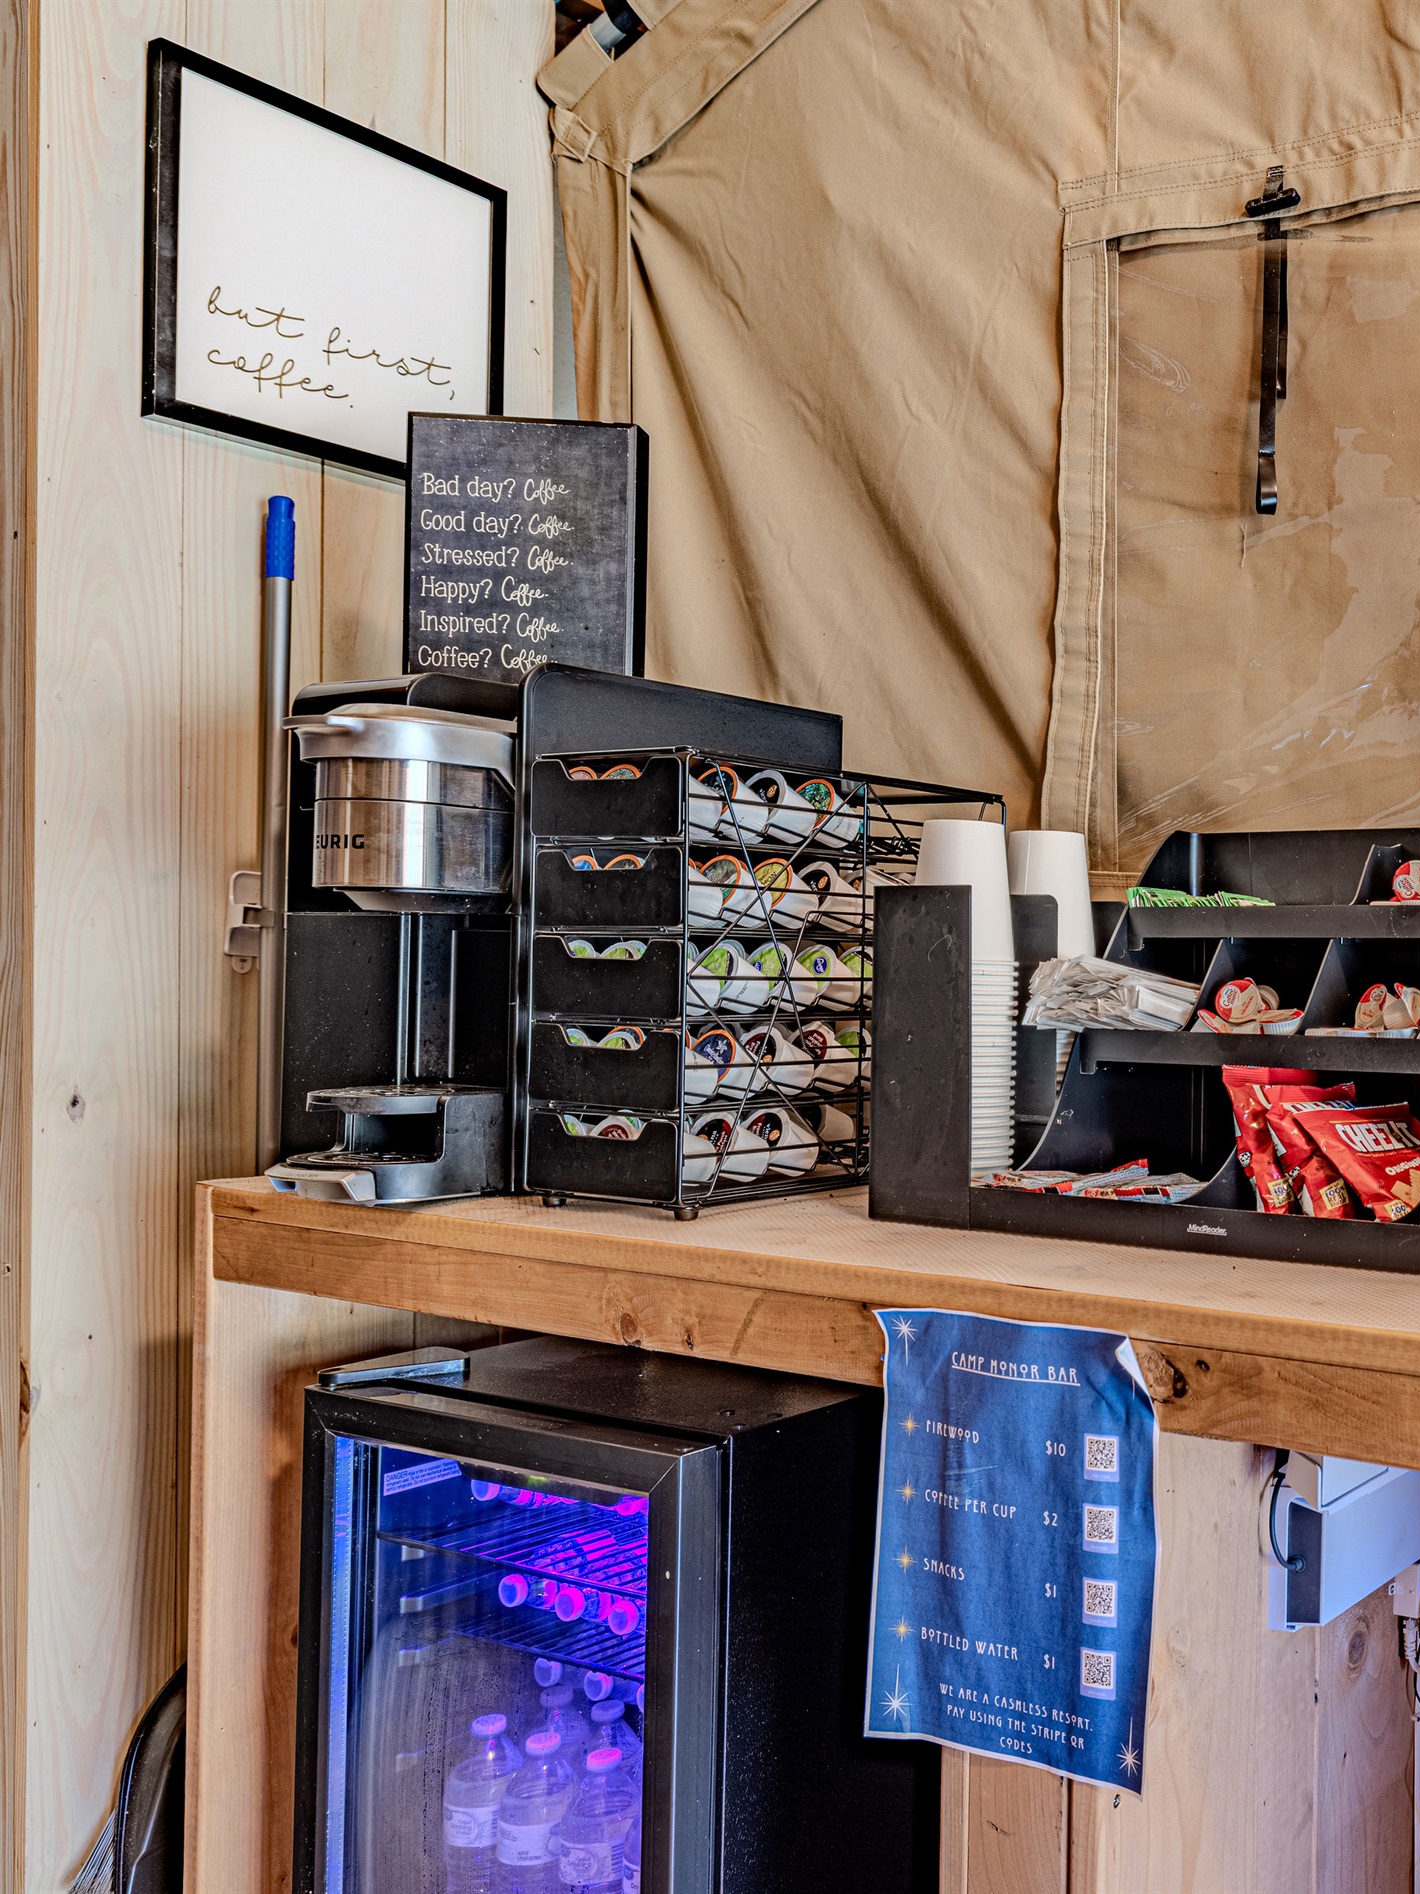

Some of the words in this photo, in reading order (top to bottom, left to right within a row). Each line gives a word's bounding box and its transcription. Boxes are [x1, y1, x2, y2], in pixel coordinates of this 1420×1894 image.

[208, 286, 306, 339] but
[322, 327, 457, 401] first,
[207, 349, 354, 409] coffee.
[422, 472, 460, 496] Bad
[467, 476, 516, 503] day?
[523, 478, 572, 505] Coffee.
[420, 509, 465, 532] Good
[472, 512, 522, 538] day?
[528, 513, 575, 539] Coffee.
[421, 543, 520, 567] Stressed?
[527, 546, 574, 574] Coffee.
[420, 575, 493, 604] Happy?
[501, 576, 549, 607] Coffee.
[419, 610, 511, 637] Inspired?
[516, 613, 564, 643] Coffee.
[418, 645, 493, 668] Coffee?
[1400, 878, 1413, 897] Coffee
[1240, 995, 1254, 1015] ORIGINAL
[952, 1351, 985, 1371] CAMP
[990, 1359, 1039, 1379] HONOR
[1047, 1366, 1079, 1384] BAR
[926, 1419, 980, 1444] FIREWOOD
[1045, 1440, 1066, 1457] $10
[925, 1488, 960, 1511] COFFEE
[964, 1499, 987, 1514] PER
[993, 1504, 1017, 1519] CUP
[1043, 1510, 1058, 1527] $2
[923, 1557, 965, 1581] SNACKS
[1044, 1582, 1057, 1598] $1
[921, 1626, 969, 1651] BOTTLED
[975, 1640, 1018, 1661] WATER
[1043, 1654, 1055, 1670] $1
[939, 1683, 954, 1697] WE
[958, 1686, 978, 1702] ARE
[982, 1693, 989, 1704] A
[994, 1695, 1048, 1718] CASHLESS
[1052, 1709, 1094, 1732] RESORT.
[946, 1705, 964, 1719] PAY
[970, 1711, 1002, 1728] USING
[1007, 1718, 1026, 1733] THE
[1031, 1723, 1067, 1744] STRIPE
[1070, 1735, 1085, 1750] QR
[1000, 1736, 1033, 1754] CODES
